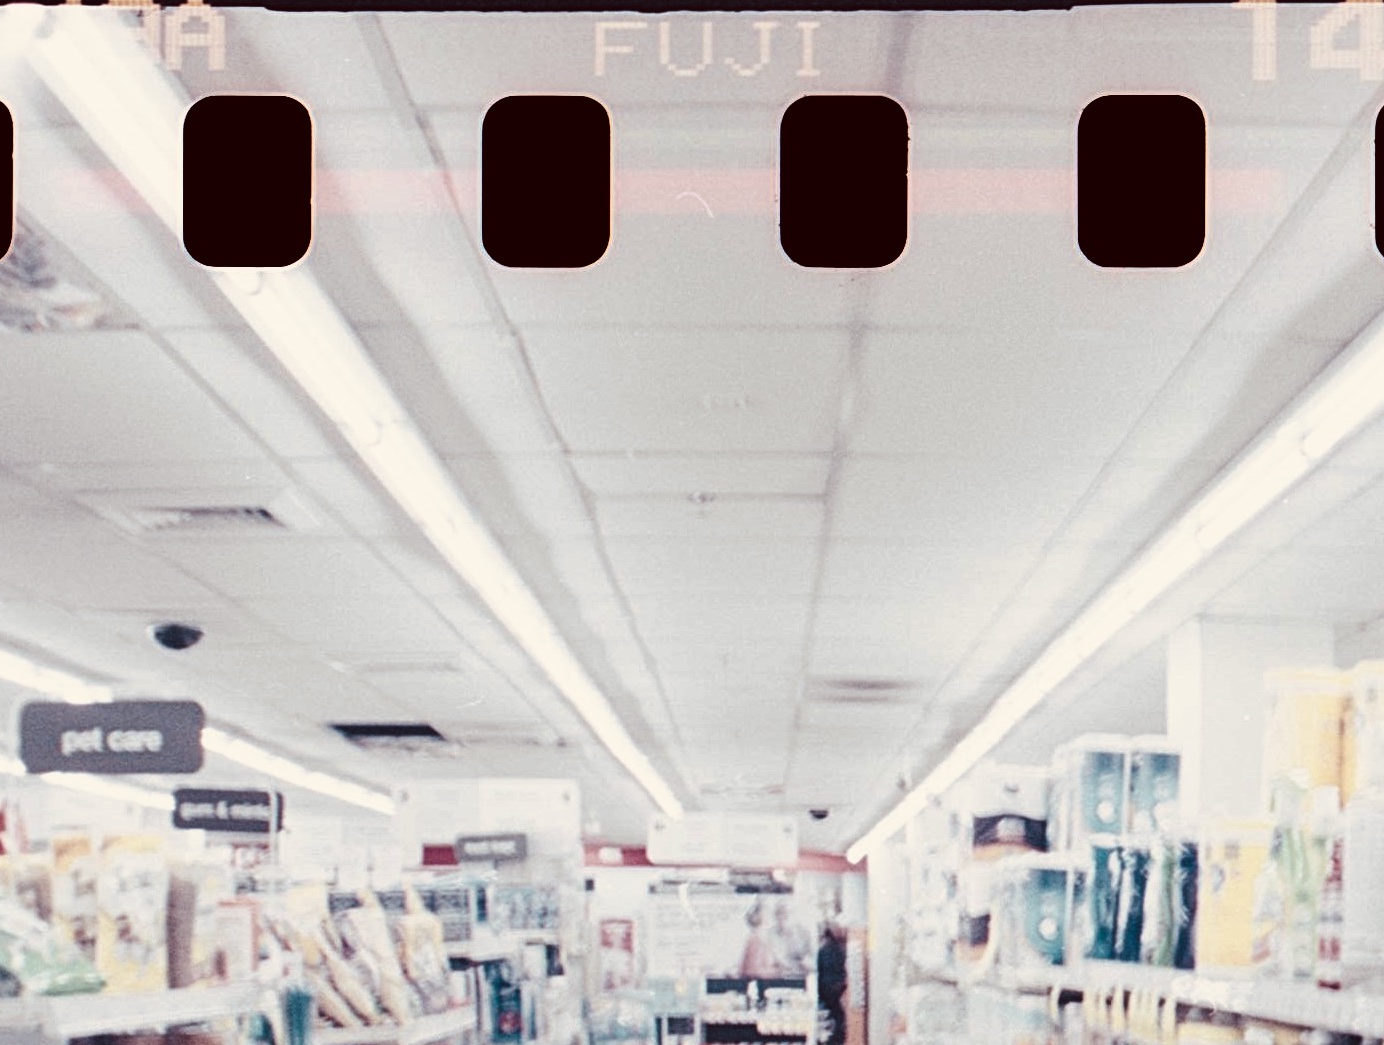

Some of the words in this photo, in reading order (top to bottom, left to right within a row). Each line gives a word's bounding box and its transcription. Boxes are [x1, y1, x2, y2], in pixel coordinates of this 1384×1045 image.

[594, 21, 821, 77] FUJI
[61, 726, 104, 757] pet
[106, 729, 164, 754] care
